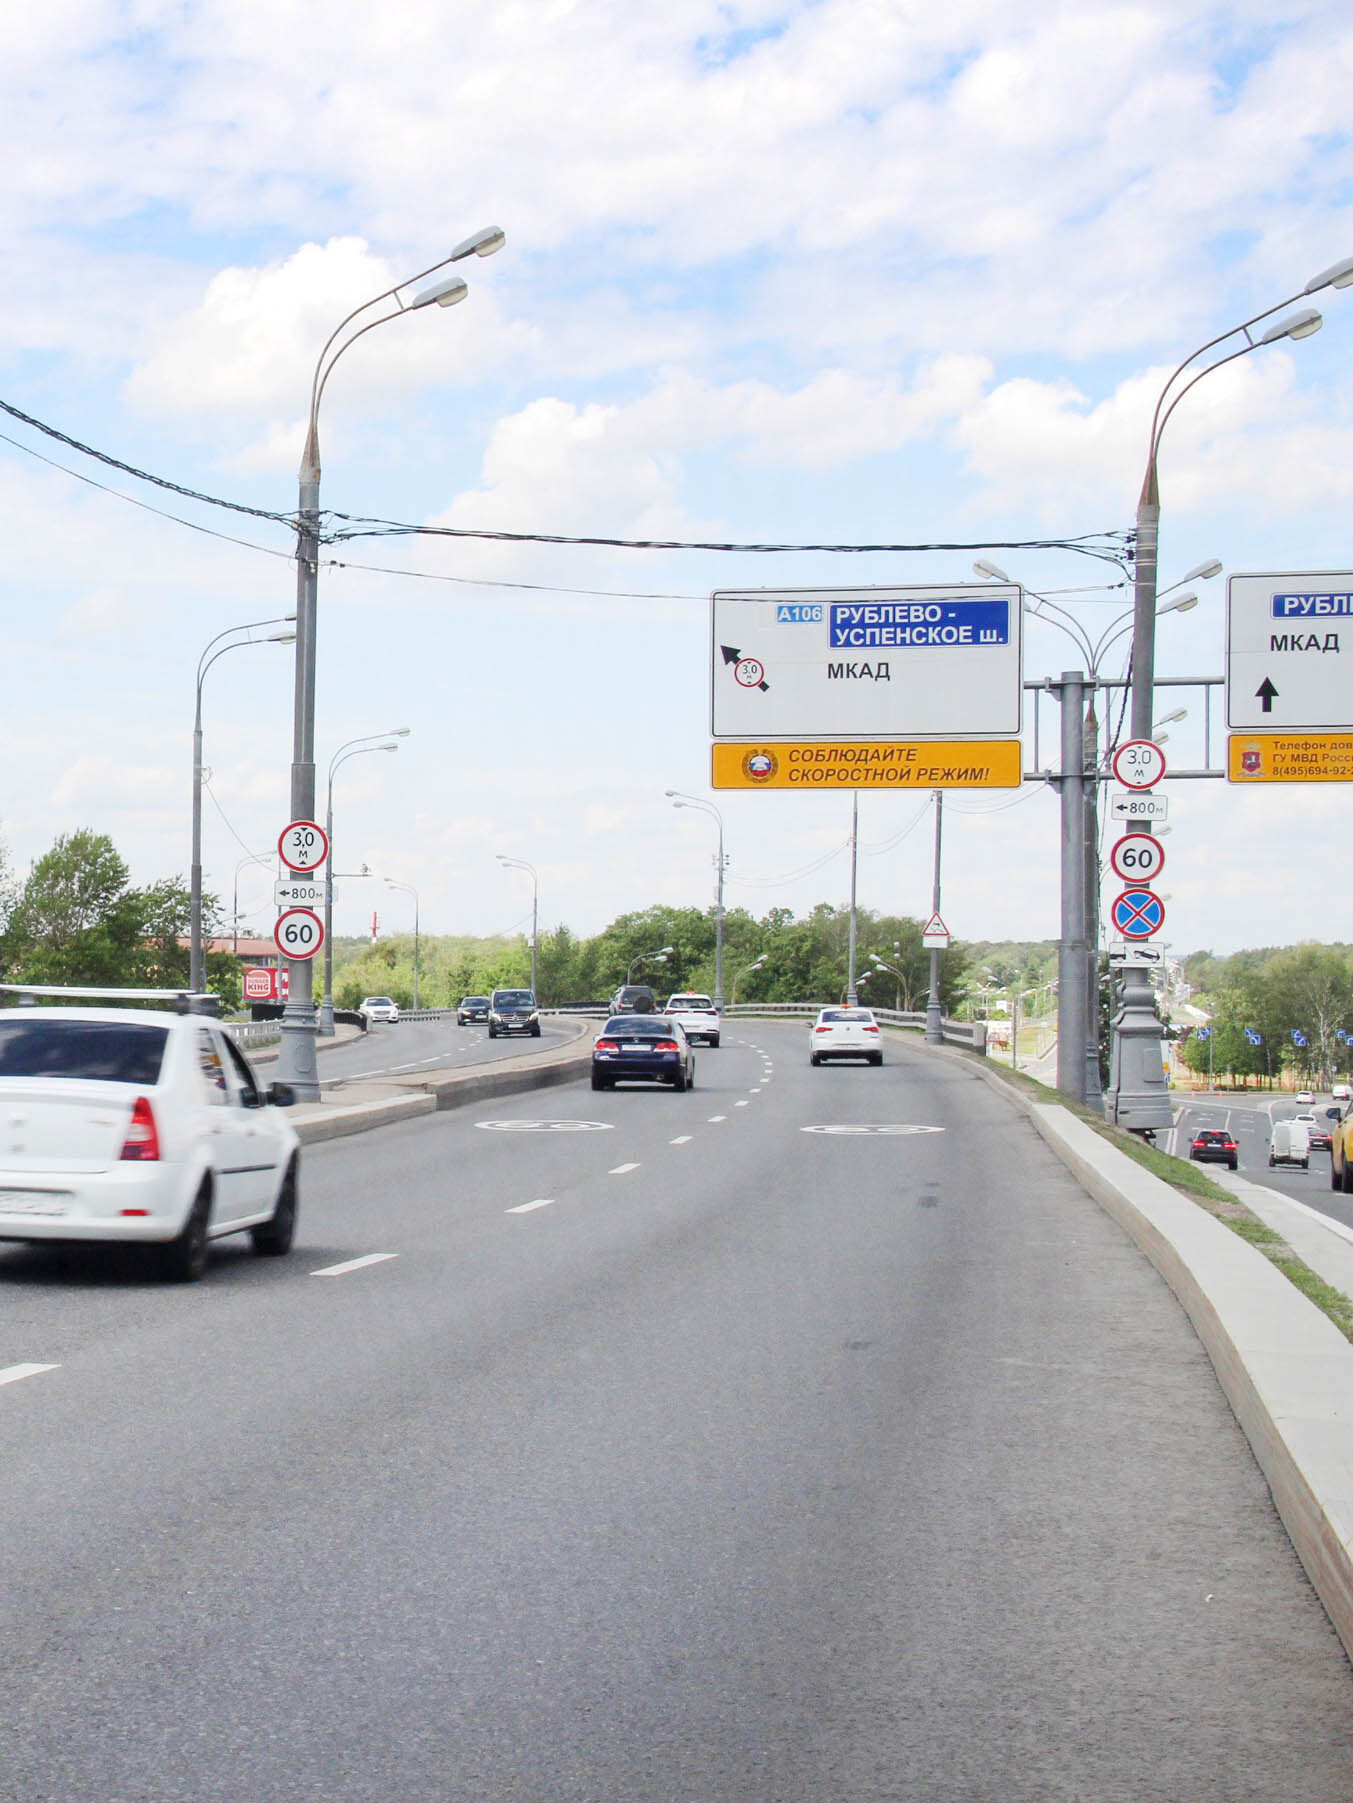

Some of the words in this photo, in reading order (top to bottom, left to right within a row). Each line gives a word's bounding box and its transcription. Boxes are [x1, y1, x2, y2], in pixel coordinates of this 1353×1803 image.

[778, 607, 822, 622] А106
[836, 605, 942, 624] РУБЛЕВО
[1284, 596, 1353, 615] РУБЛ
[836, 626, 973, 645] УСПЕНСКОЕ
[980, 629, 1004, 643] ш.
[1270, 634, 1340, 653] МКАД
[828, 662, 891, 681] МКАД
[789, 746, 918, 765] СОБЛЮДАЙТЕ
[1273, 741, 1326, 751] Телефон
[1273, 754, 1286, 763] ГУ
[1291, 753, 1318, 763] МВД
[1322, 753, 1353, 762] Росс
[789, 765, 912, 781] СКОРОСТНОЙ
[916, 767, 990, 781] РЕЖИМ!
[293, 832, 314, 848] 3,0
[1123, 848, 1152, 868] 60
[285, 924, 312, 943] 60
